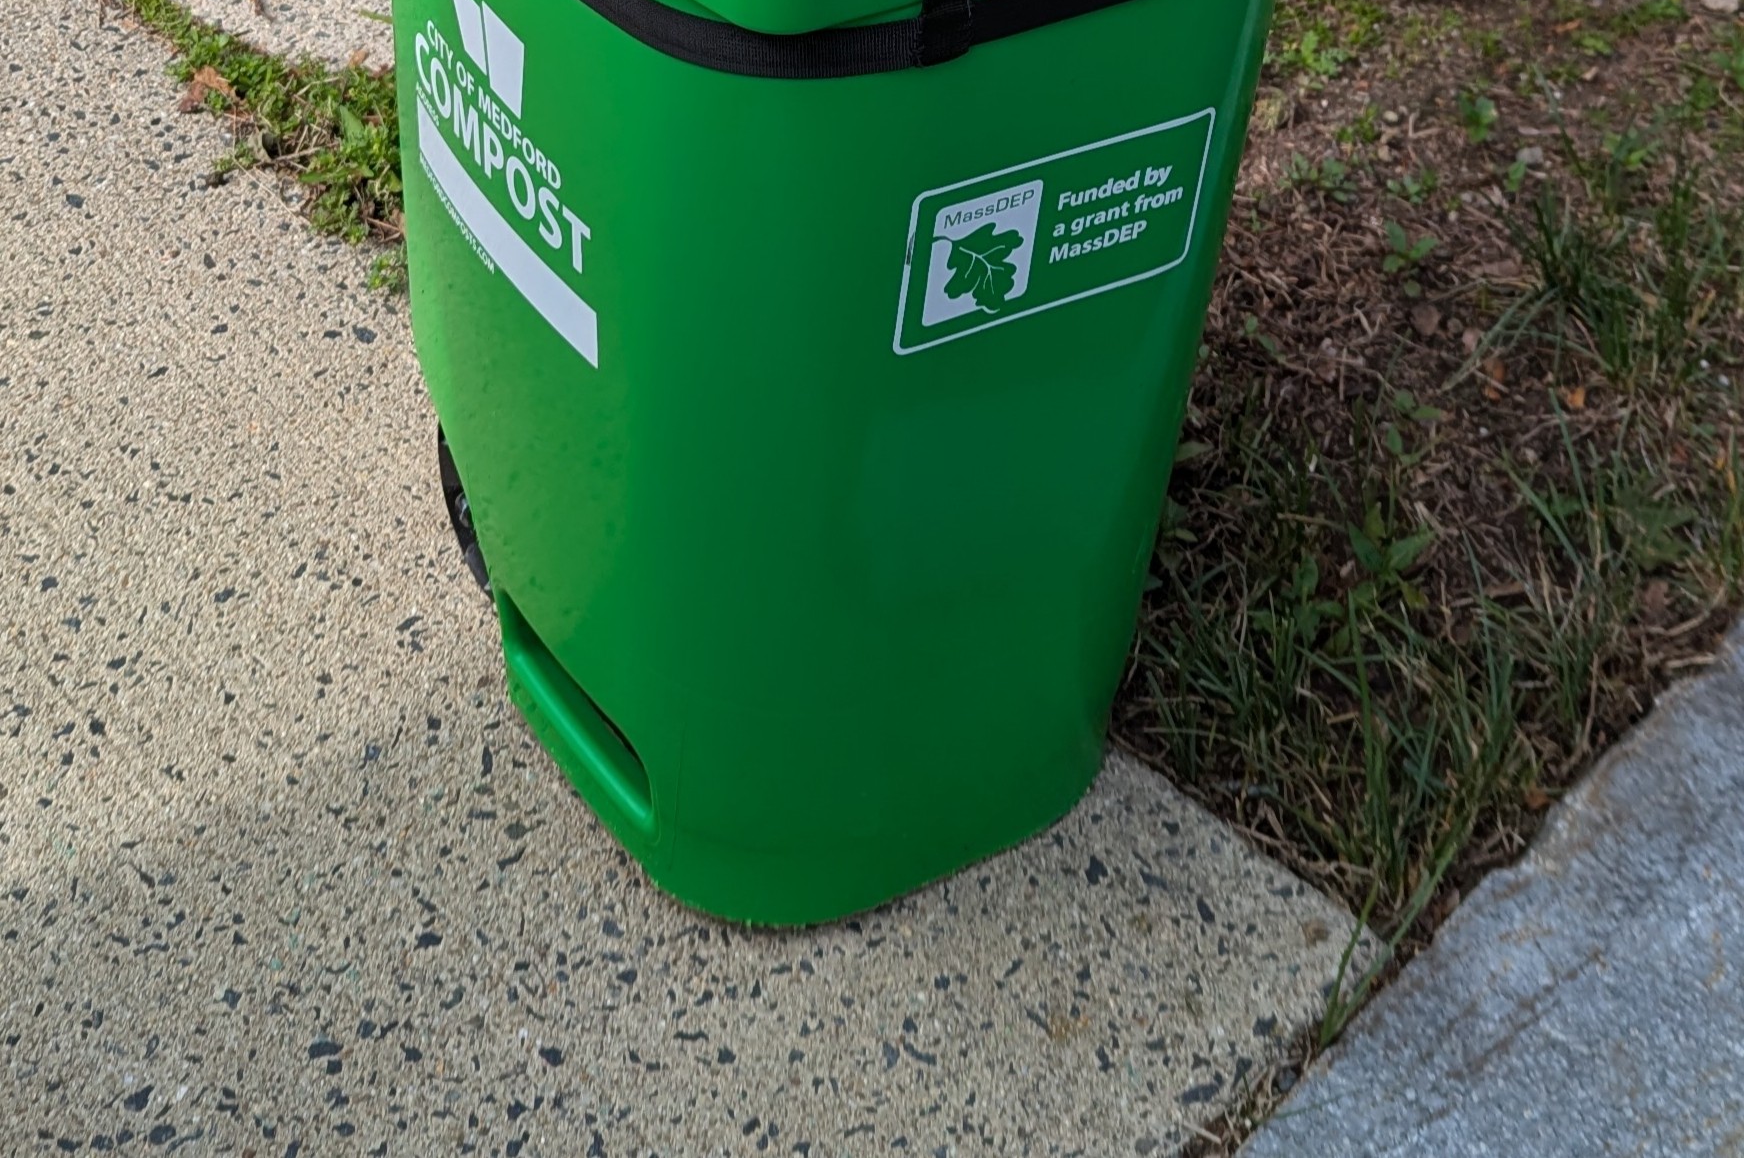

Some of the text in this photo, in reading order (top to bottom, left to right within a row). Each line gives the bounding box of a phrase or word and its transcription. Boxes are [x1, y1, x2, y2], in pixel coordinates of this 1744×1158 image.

[427, 20, 561, 189] CITY OF MEDFORD
[415, 32, 591, 274] COMPOST
[943, 189, 1035, 229] MassDEP
[1052, 186, 1184, 237] a grant from
[1057, 164, 1173, 211] Funded by
[1048, 220, 1147, 264] MassDEP
